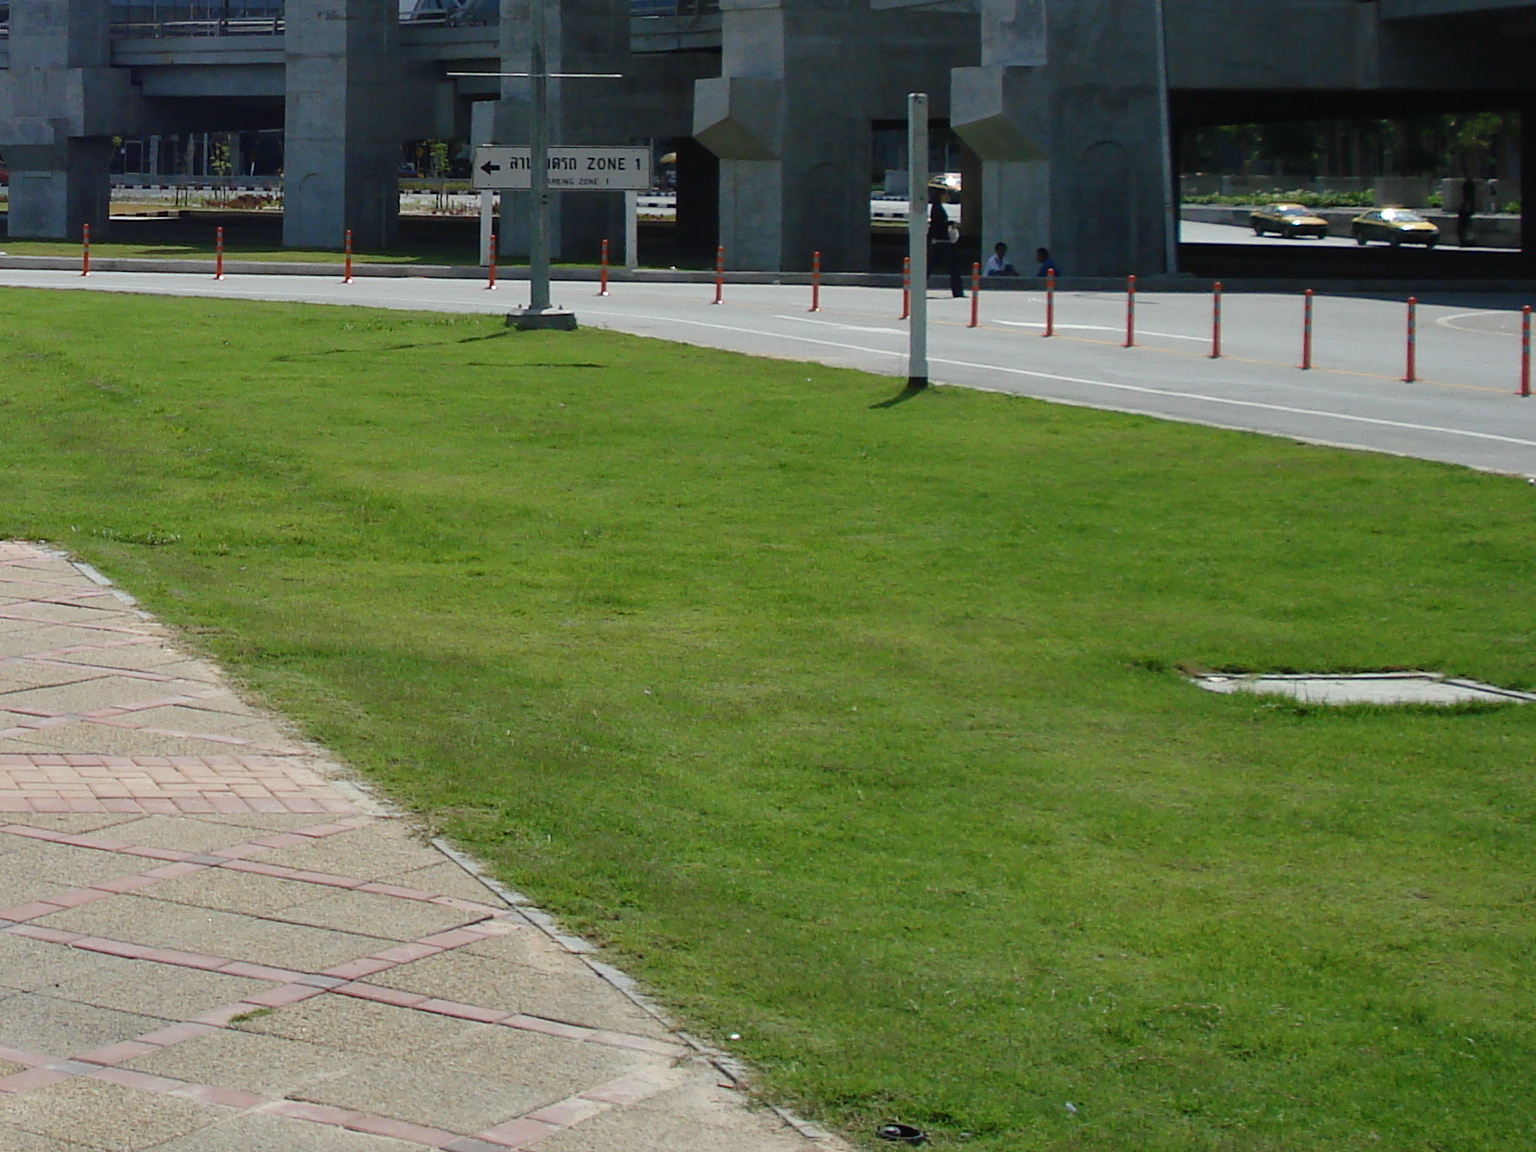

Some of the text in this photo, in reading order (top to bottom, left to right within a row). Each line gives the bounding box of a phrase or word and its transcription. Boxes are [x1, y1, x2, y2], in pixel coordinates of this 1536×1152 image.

[587, 157, 625, 170] ZONE
[635, 158, 641, 170] 1
[579, 178, 598, 186] ZONE
